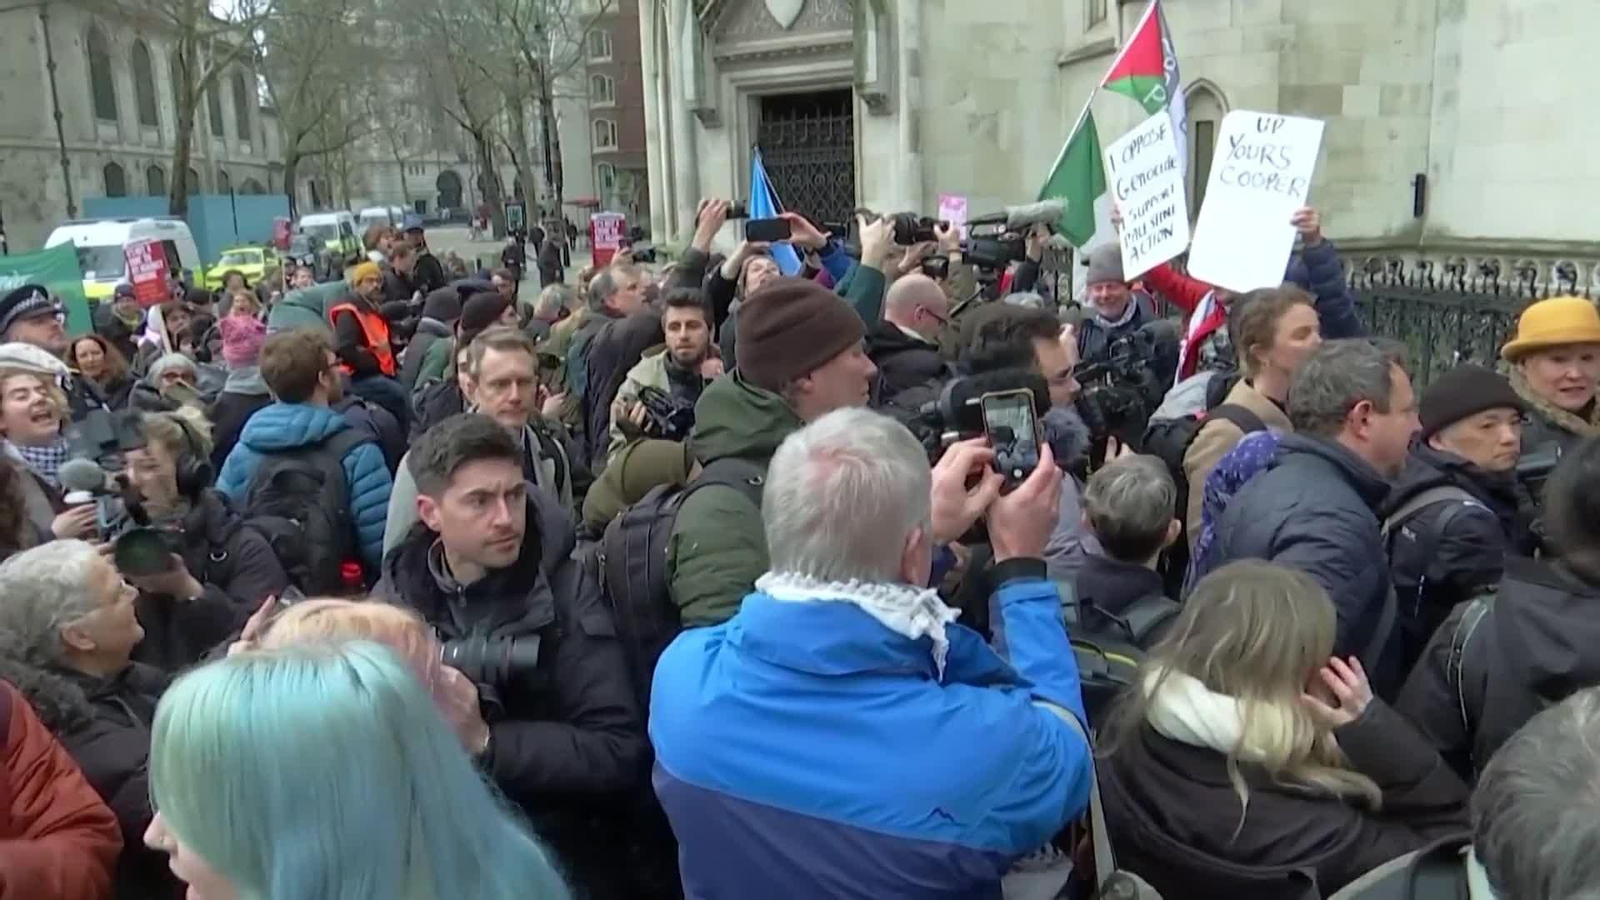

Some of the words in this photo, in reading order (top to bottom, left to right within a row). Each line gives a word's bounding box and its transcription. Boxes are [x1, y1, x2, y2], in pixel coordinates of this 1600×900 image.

[1257, 117, 1285, 134] UP
[1109, 154, 1116, 173] I
[1122, 122, 1167, 164] OPPOSE
[1227, 133, 1293, 170] YOURS
[1220, 164, 1306, 198] COOPER
[1129, 183, 1175, 221] SUPPORT
[1130, 224, 1174, 265] ACTION
